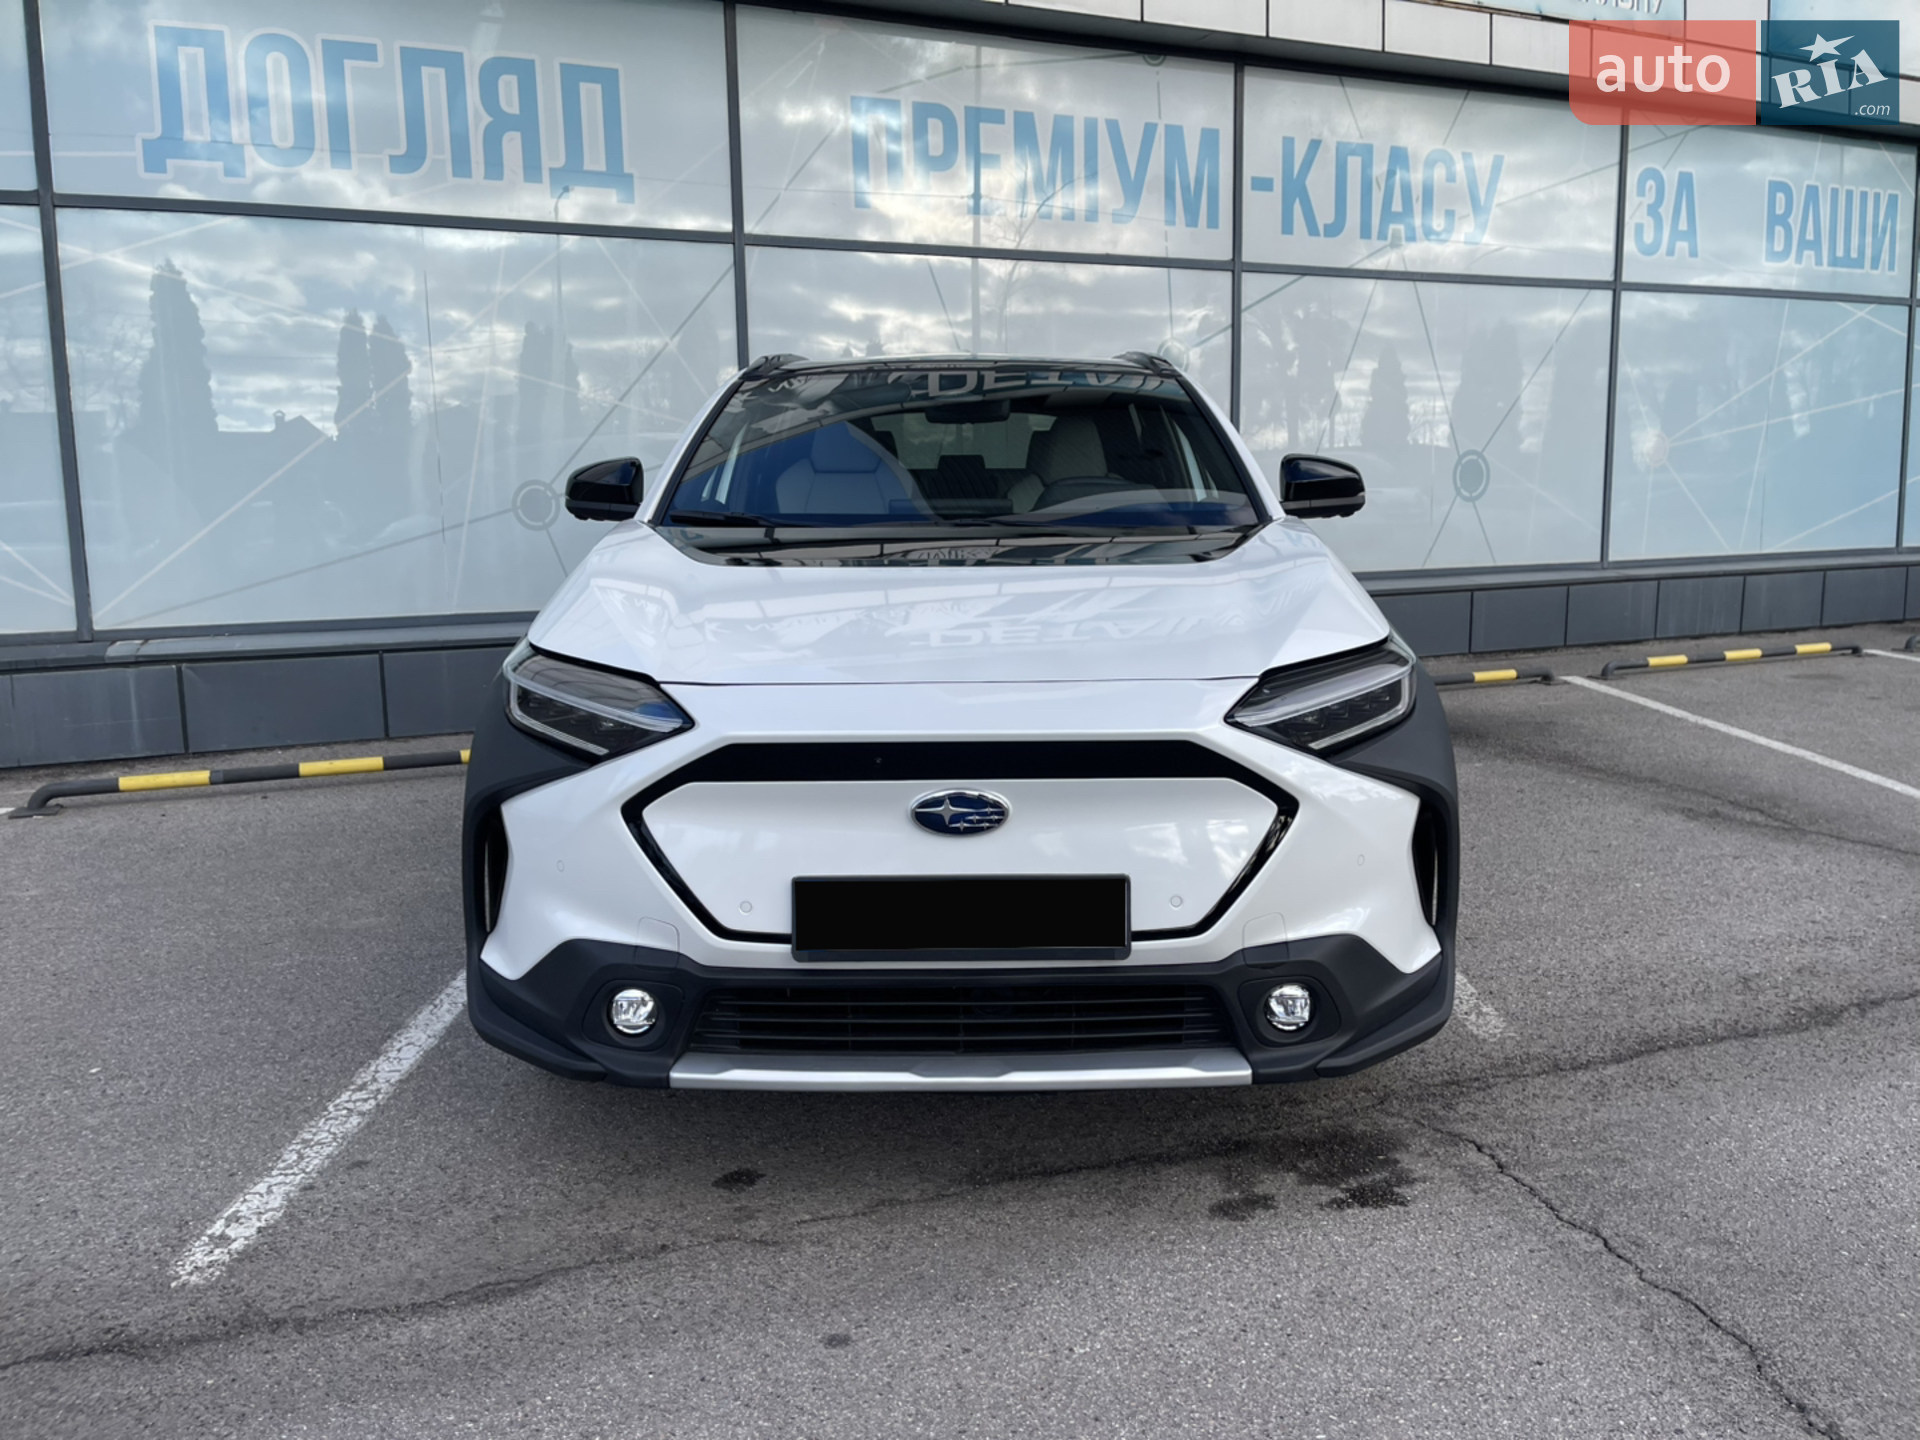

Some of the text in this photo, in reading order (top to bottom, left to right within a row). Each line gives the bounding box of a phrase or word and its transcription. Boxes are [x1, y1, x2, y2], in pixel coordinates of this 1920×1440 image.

[140, 23, 636, 205] ДОГЛЯД
[1633, 166, 1699, 259] ЗА
[1763, 178, 1900, 273] ВАШИ
